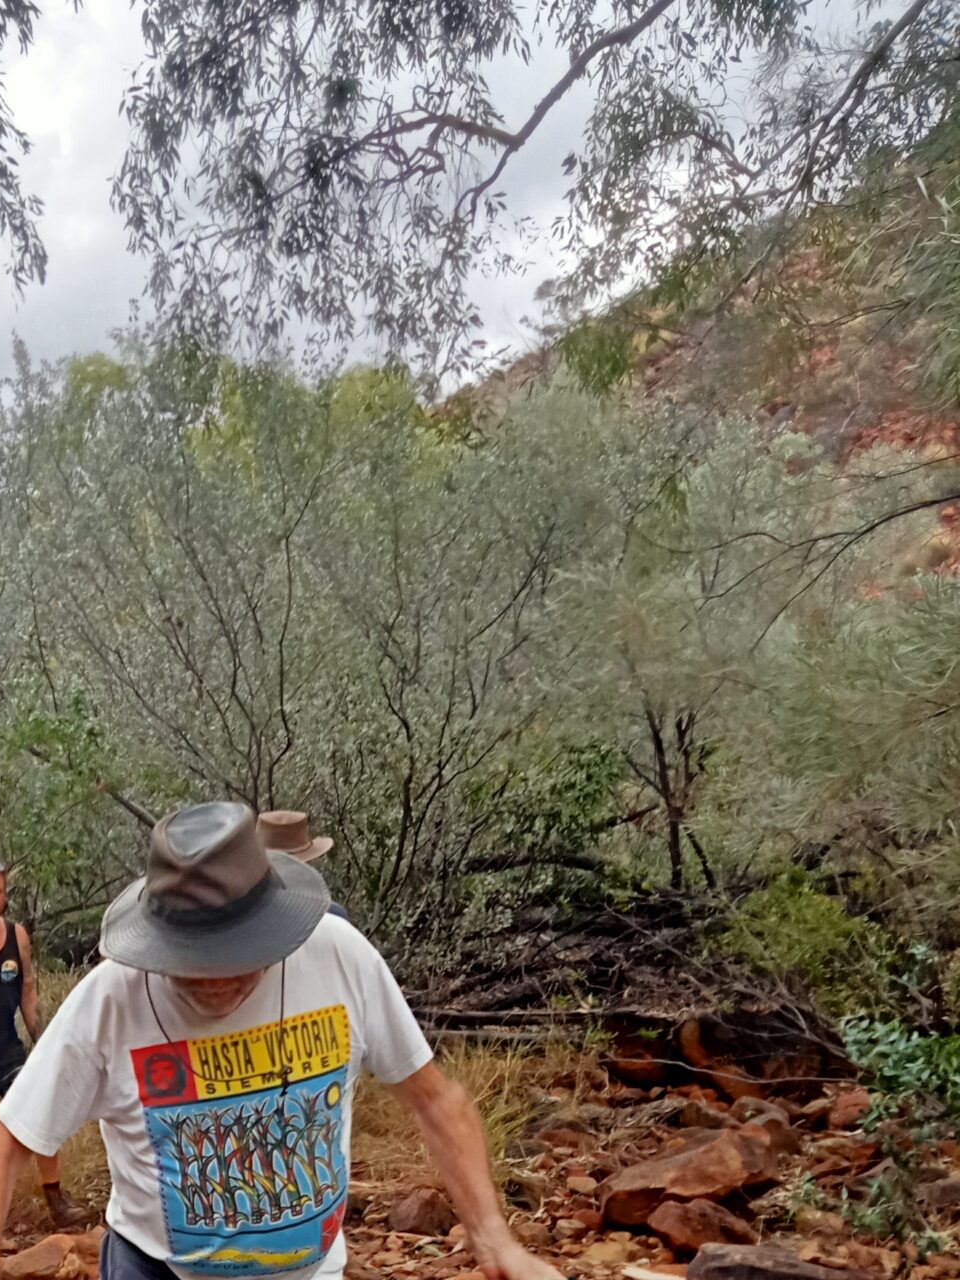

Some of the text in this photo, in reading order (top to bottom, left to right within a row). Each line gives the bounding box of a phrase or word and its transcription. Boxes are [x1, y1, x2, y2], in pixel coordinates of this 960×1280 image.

[196, 1015, 340, 1082] HASTA LA VICTORIA
